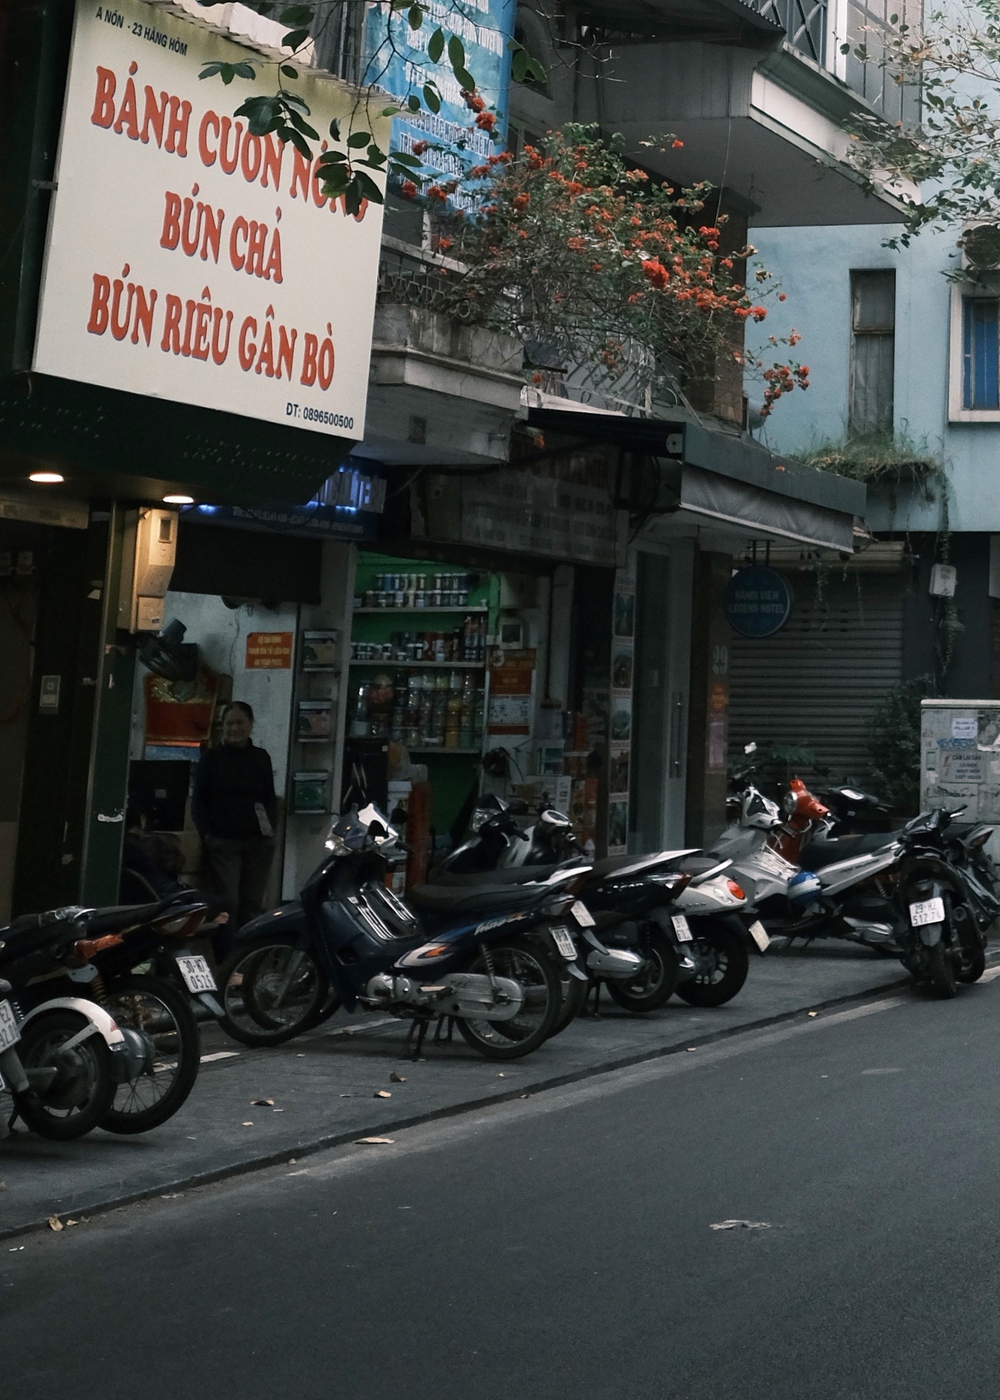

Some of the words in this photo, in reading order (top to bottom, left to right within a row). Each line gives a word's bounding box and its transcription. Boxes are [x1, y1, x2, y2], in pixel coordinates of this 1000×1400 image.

[104, 9, 125, 29] NÓN
[131, 22, 143, 37] 23
[143, 26, 168, 48] HÀNG
[168, 36, 189, 56] HÒM
[91, 60, 193, 158] BÁNH
[289, 140, 370, 223] NÓ
[160, 182, 225, 265] BÚN
[229, 206, 283, 284] CHẢ
[87, 263, 158, 348] BÚN
[160, 285, 234, 366] RIÊU
[238, 304, 298, 382] GÂN
[300, 322, 335, 391] BÒ
[286, 402, 301, 419] ĐT:
[302, 407, 354, 431] 0896500500
[760, 603, 785, 614] HOTEL
